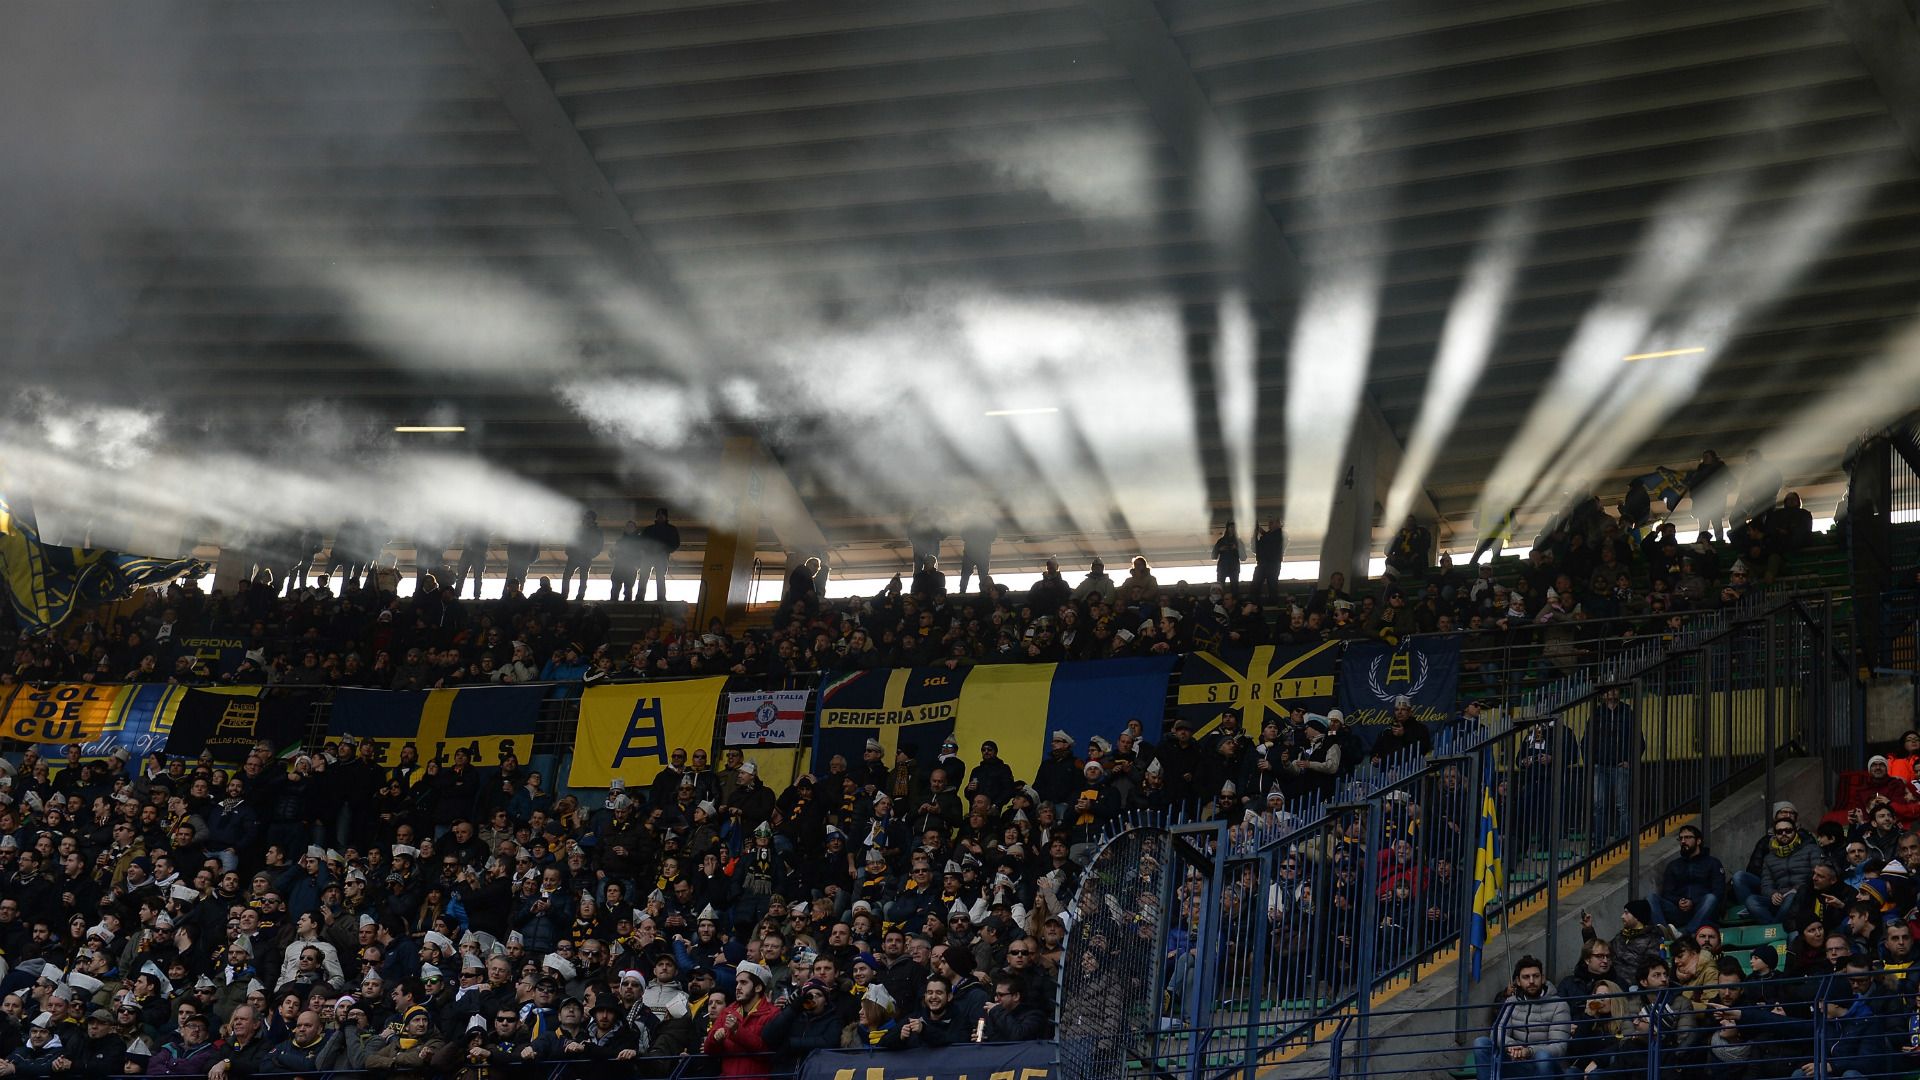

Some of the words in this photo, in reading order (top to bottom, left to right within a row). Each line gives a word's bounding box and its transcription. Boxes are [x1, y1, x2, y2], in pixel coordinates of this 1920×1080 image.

[1344, 465, 1354, 490] 4
[180, 638, 243, 648] VERONA
[922, 676, 949, 687] SGL
[1207, 679, 1318, 702] SORRY!
[734, 694, 773, 703] CHELSEA
[34, 702, 83, 720] DE
[827, 710, 915, 725] PERIFERIA
[919, 705, 952, 721] SUD
[14, 718, 87, 740] CUL
[741, 729, 785, 739] VERONA
